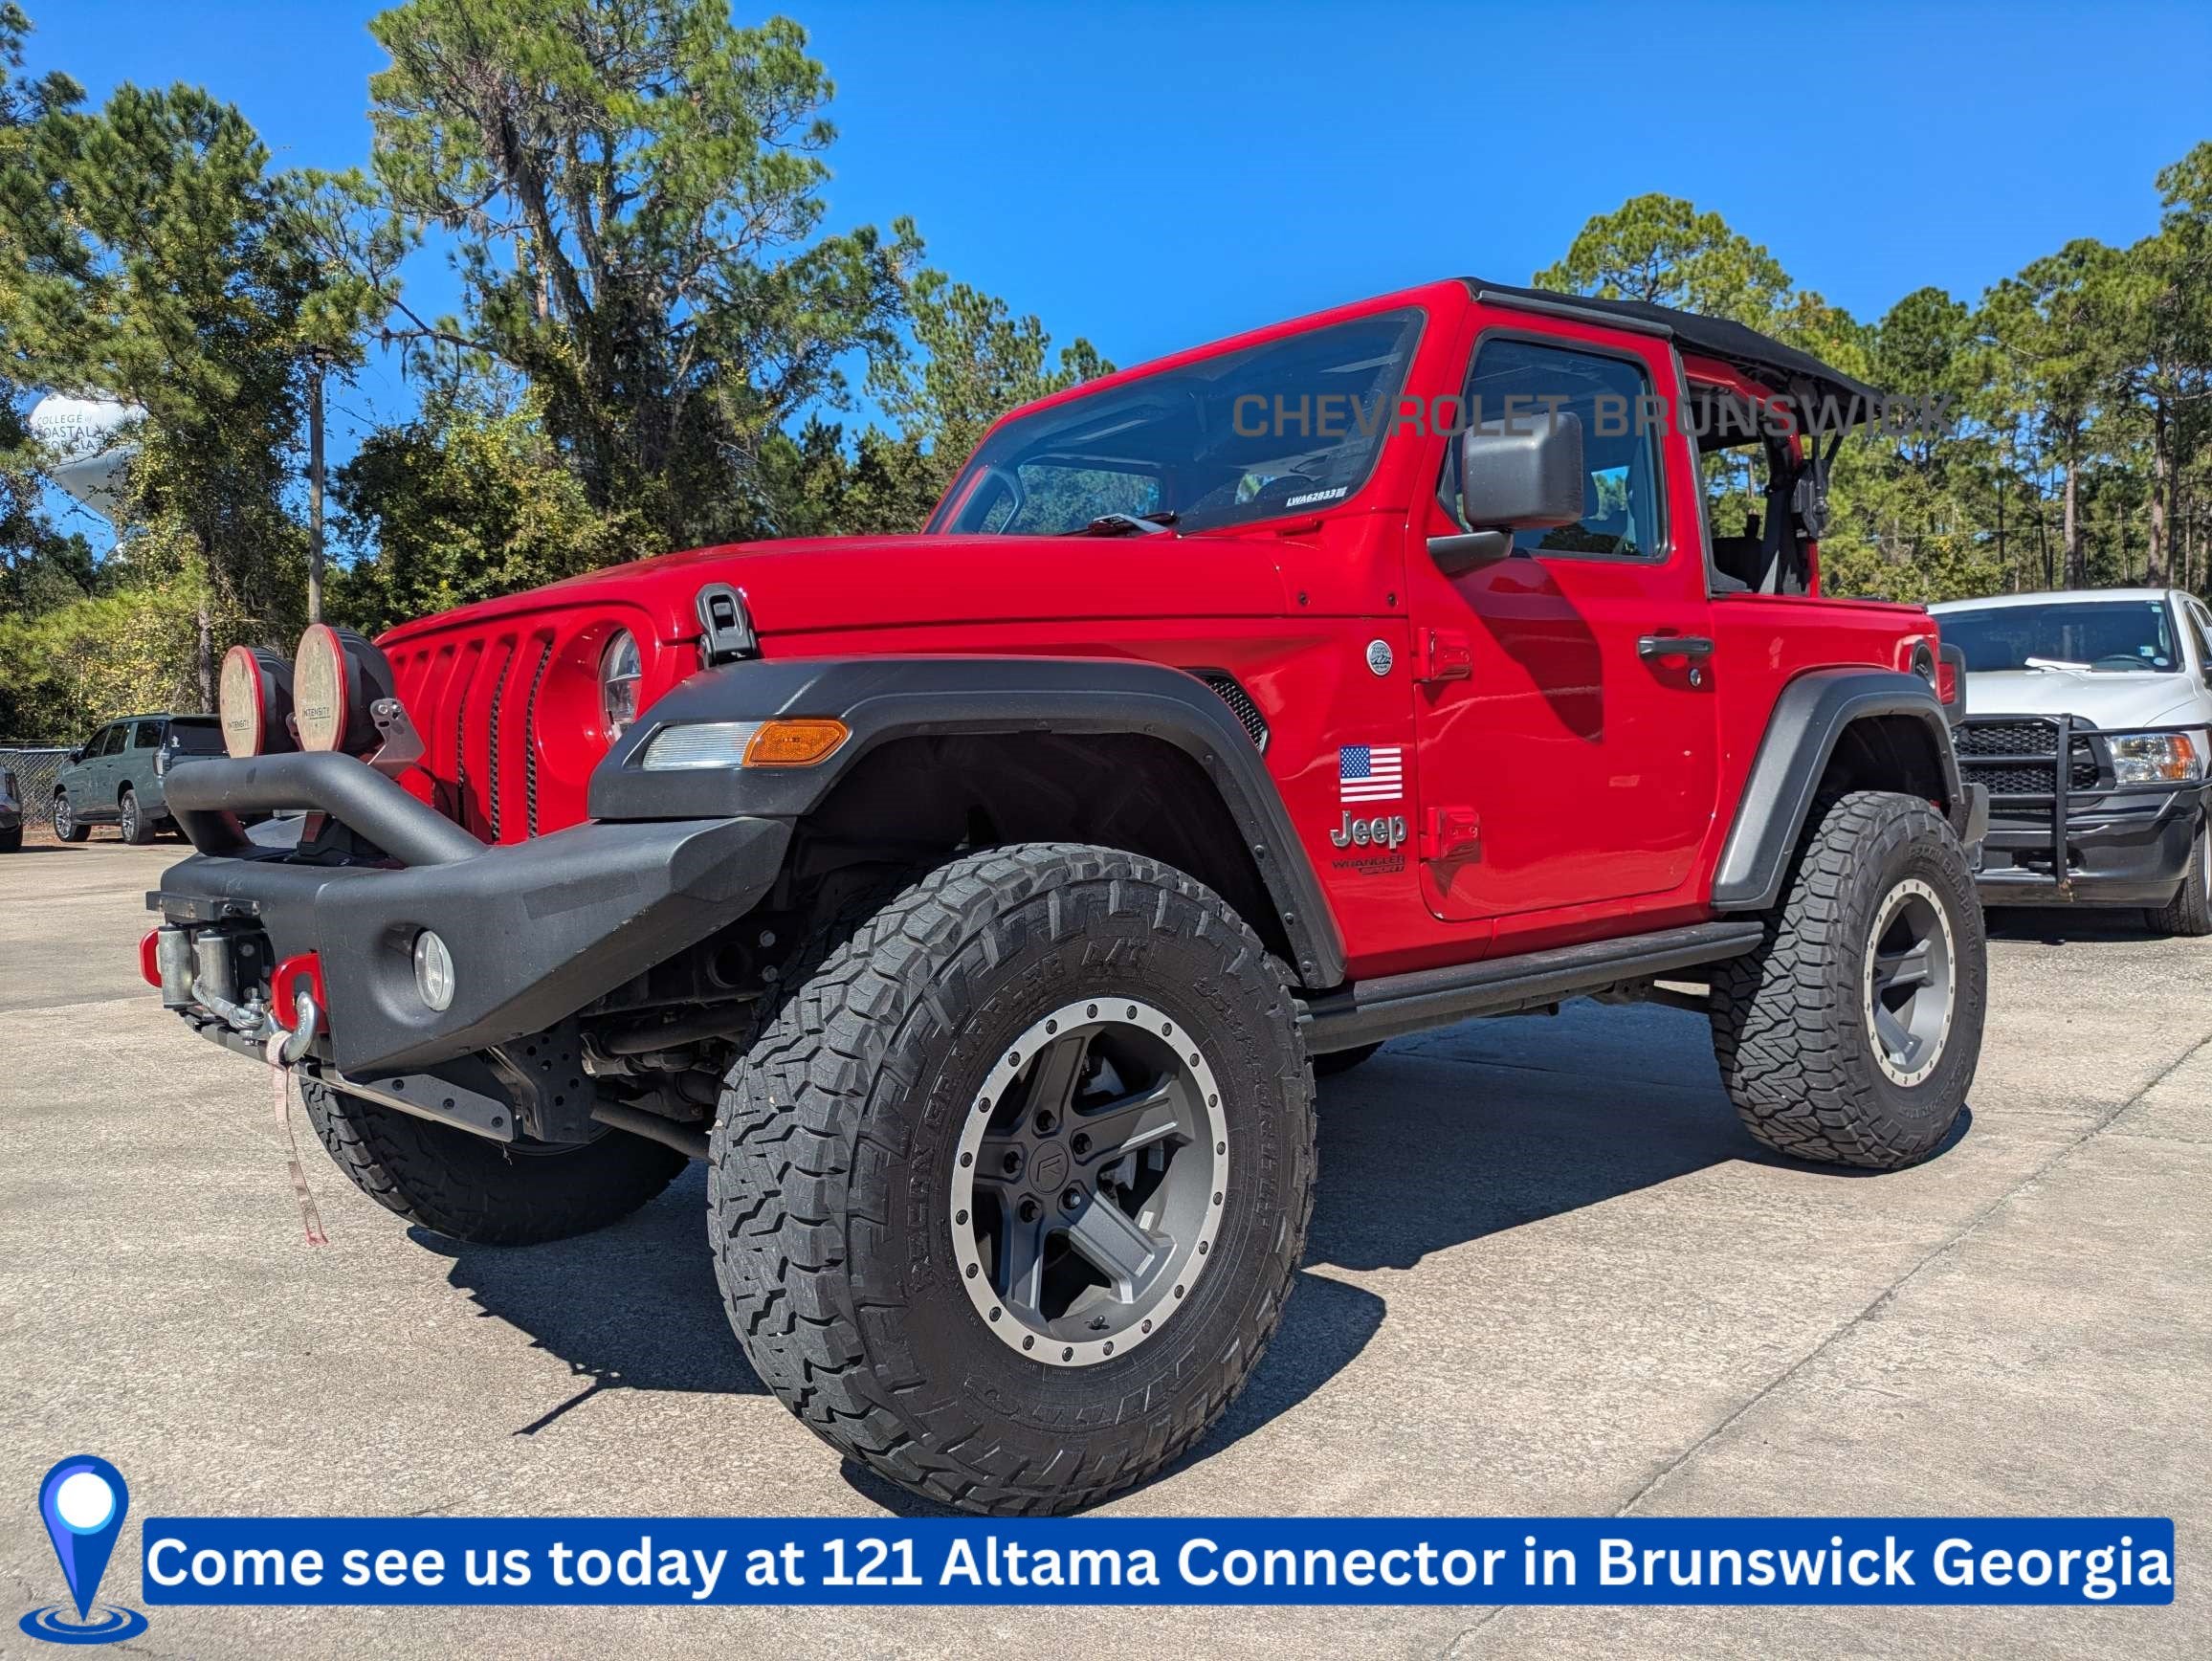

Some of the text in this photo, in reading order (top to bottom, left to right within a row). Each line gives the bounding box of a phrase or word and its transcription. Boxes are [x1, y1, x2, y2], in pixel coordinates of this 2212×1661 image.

[37, 414, 82, 426] COLLEGE
[38, 426, 95, 439] OASTAL
[1329, 809, 1407, 850] Jeep
[1332, 854, 1405, 869] WRANGLER
